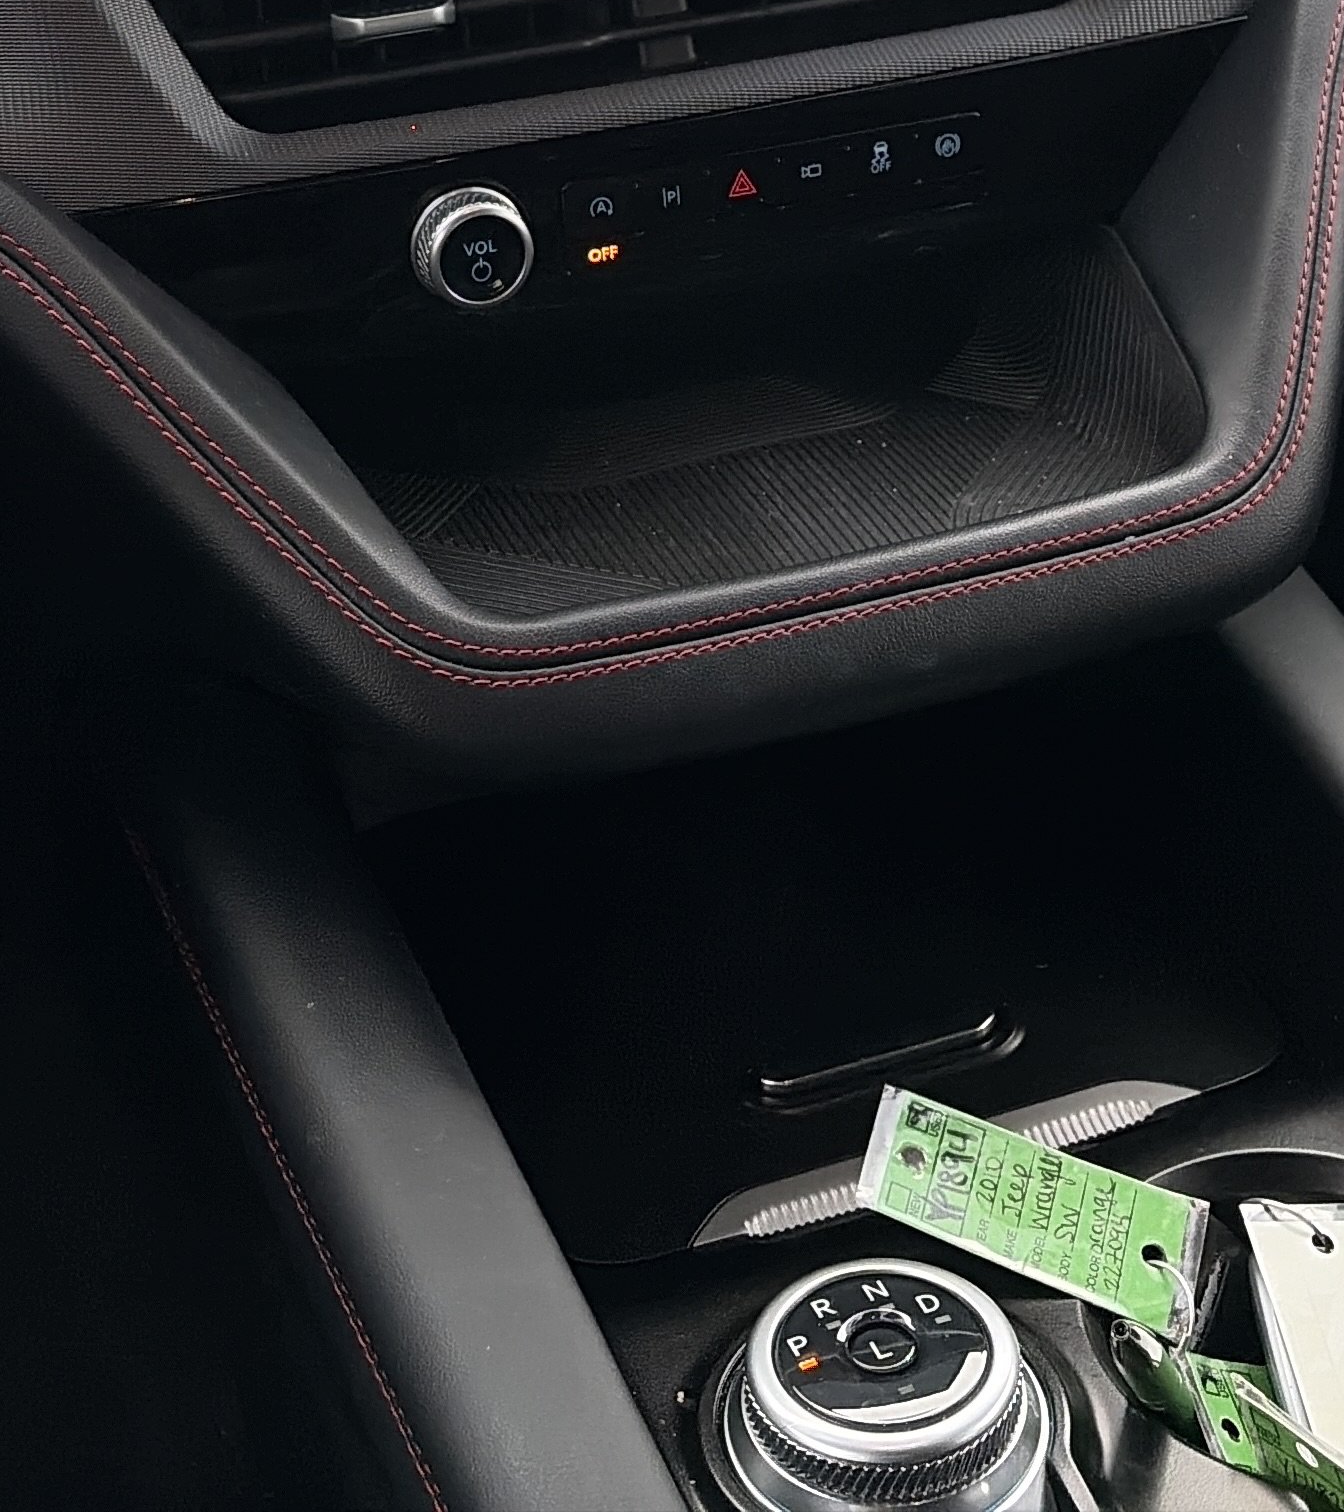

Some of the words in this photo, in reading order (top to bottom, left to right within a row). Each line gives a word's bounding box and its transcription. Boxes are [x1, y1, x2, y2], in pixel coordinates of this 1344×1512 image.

[871, 160, 892, 174] OFF
[463, 240, 498, 257] VOL
[588, 244, 619, 264] OFF
[976, 1156, 1003, 1205] 2010
[1001, 1163, 1035, 1218] Jeep
[1028, 1146, 1077, 1232] Wrangler
[1054, 1203, 1080, 1245] SW
[862, 1279, 890, 1302] N
[810, 1298, 838, 1319] R
[915, 1294, 940, 1314] D
[787, 1335, 808, 1357] P
[869, 1340, 894, 1360] L
